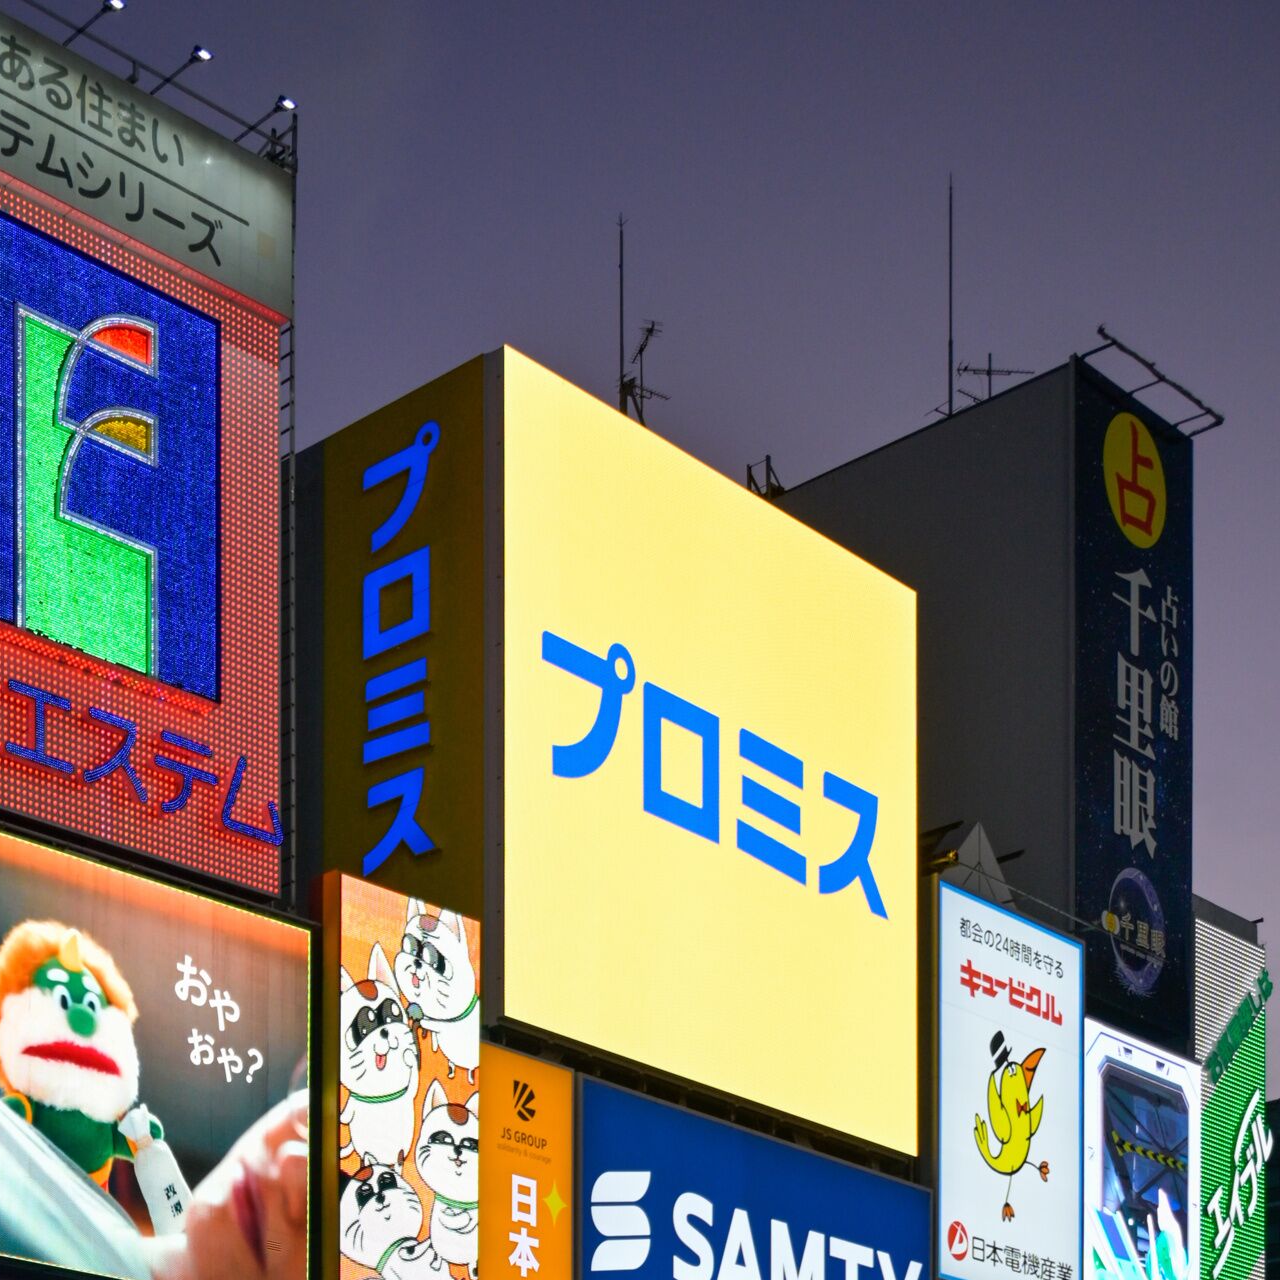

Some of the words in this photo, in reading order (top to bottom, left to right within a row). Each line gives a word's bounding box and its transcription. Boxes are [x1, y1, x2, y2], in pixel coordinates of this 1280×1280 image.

[1115, 421, 1156, 537] 占
[363, 419, 441, 877] プロミス
[1111, 567, 1158, 860] 千里眼
[1160, 584, 1179, 742] 占いの館
[541, 630, 889, 920] プロミス
[174, 955, 240, 1032] おや
[959, 916, 1064, 979] 都会の24時間を守る
[959, 958, 1063, 1026] キュービクル
[501, 1128, 512, 1141] JS
[514, 1131, 548, 1150] GROUP
[1207, 1088, 1274, 1280] エイブル
